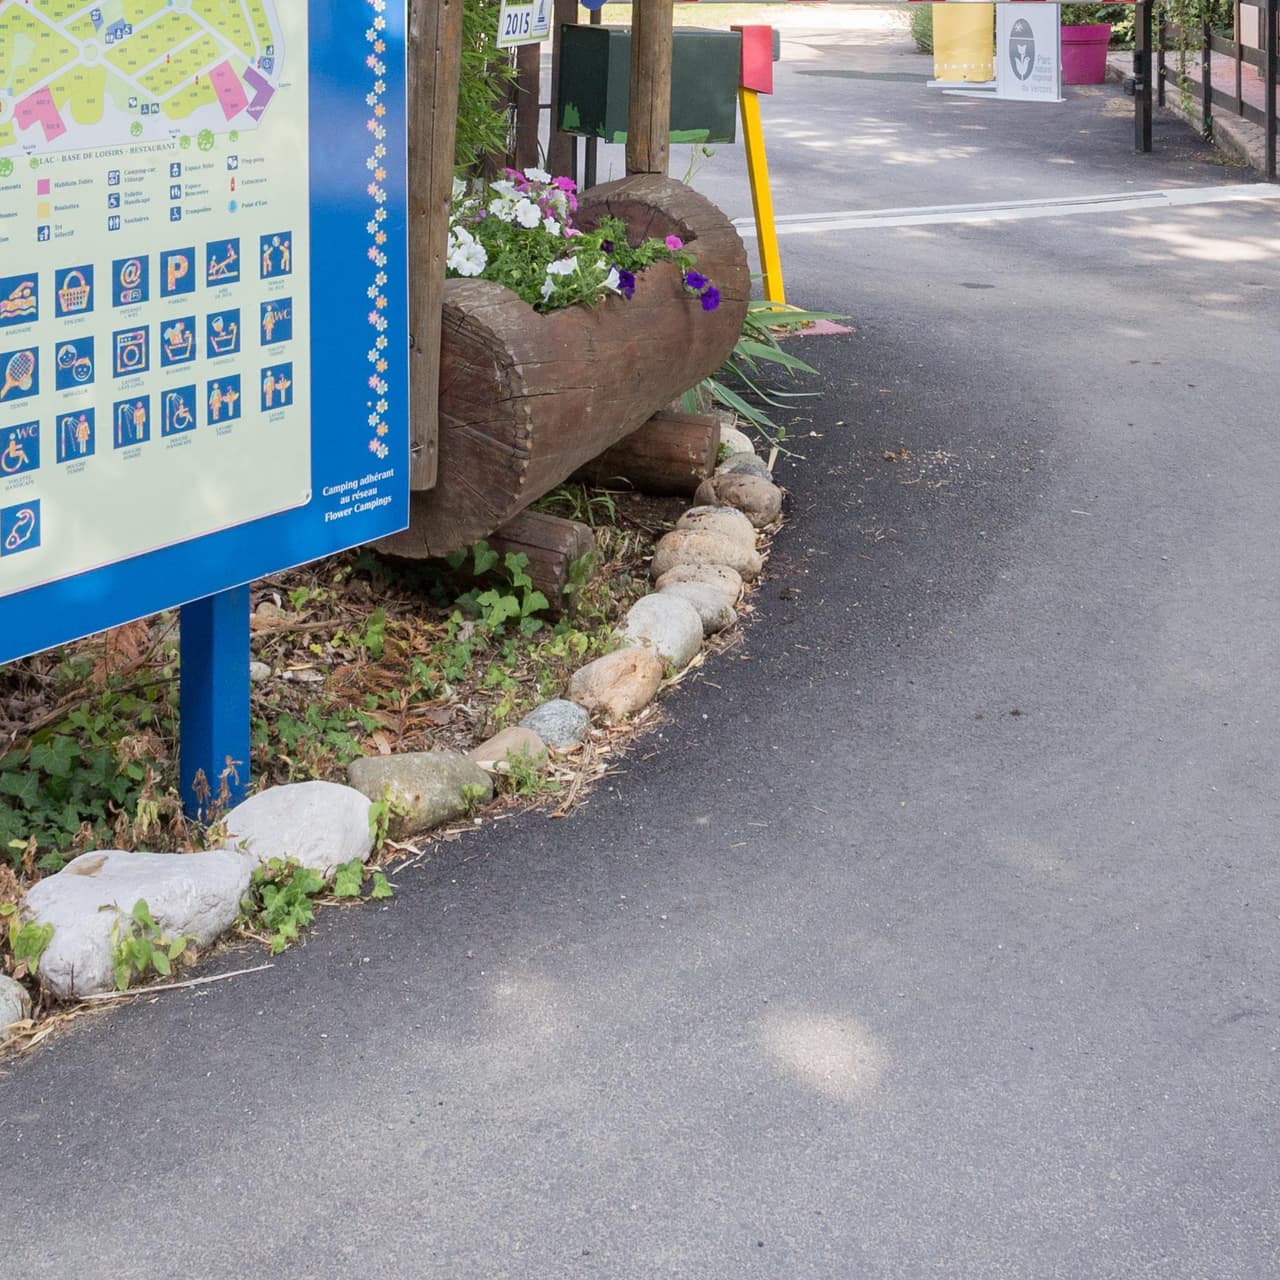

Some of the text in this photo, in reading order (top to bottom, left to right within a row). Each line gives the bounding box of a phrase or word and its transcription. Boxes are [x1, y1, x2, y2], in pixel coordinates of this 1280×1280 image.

[504, 11, 530, 36] 2015
[129, 142, 177, 154] RESTAURANT
[16, 423, 39, 441] WC
[322, 468, 395, 497] Camping adhérant
[324, 495, 393, 523] Flower Campings
